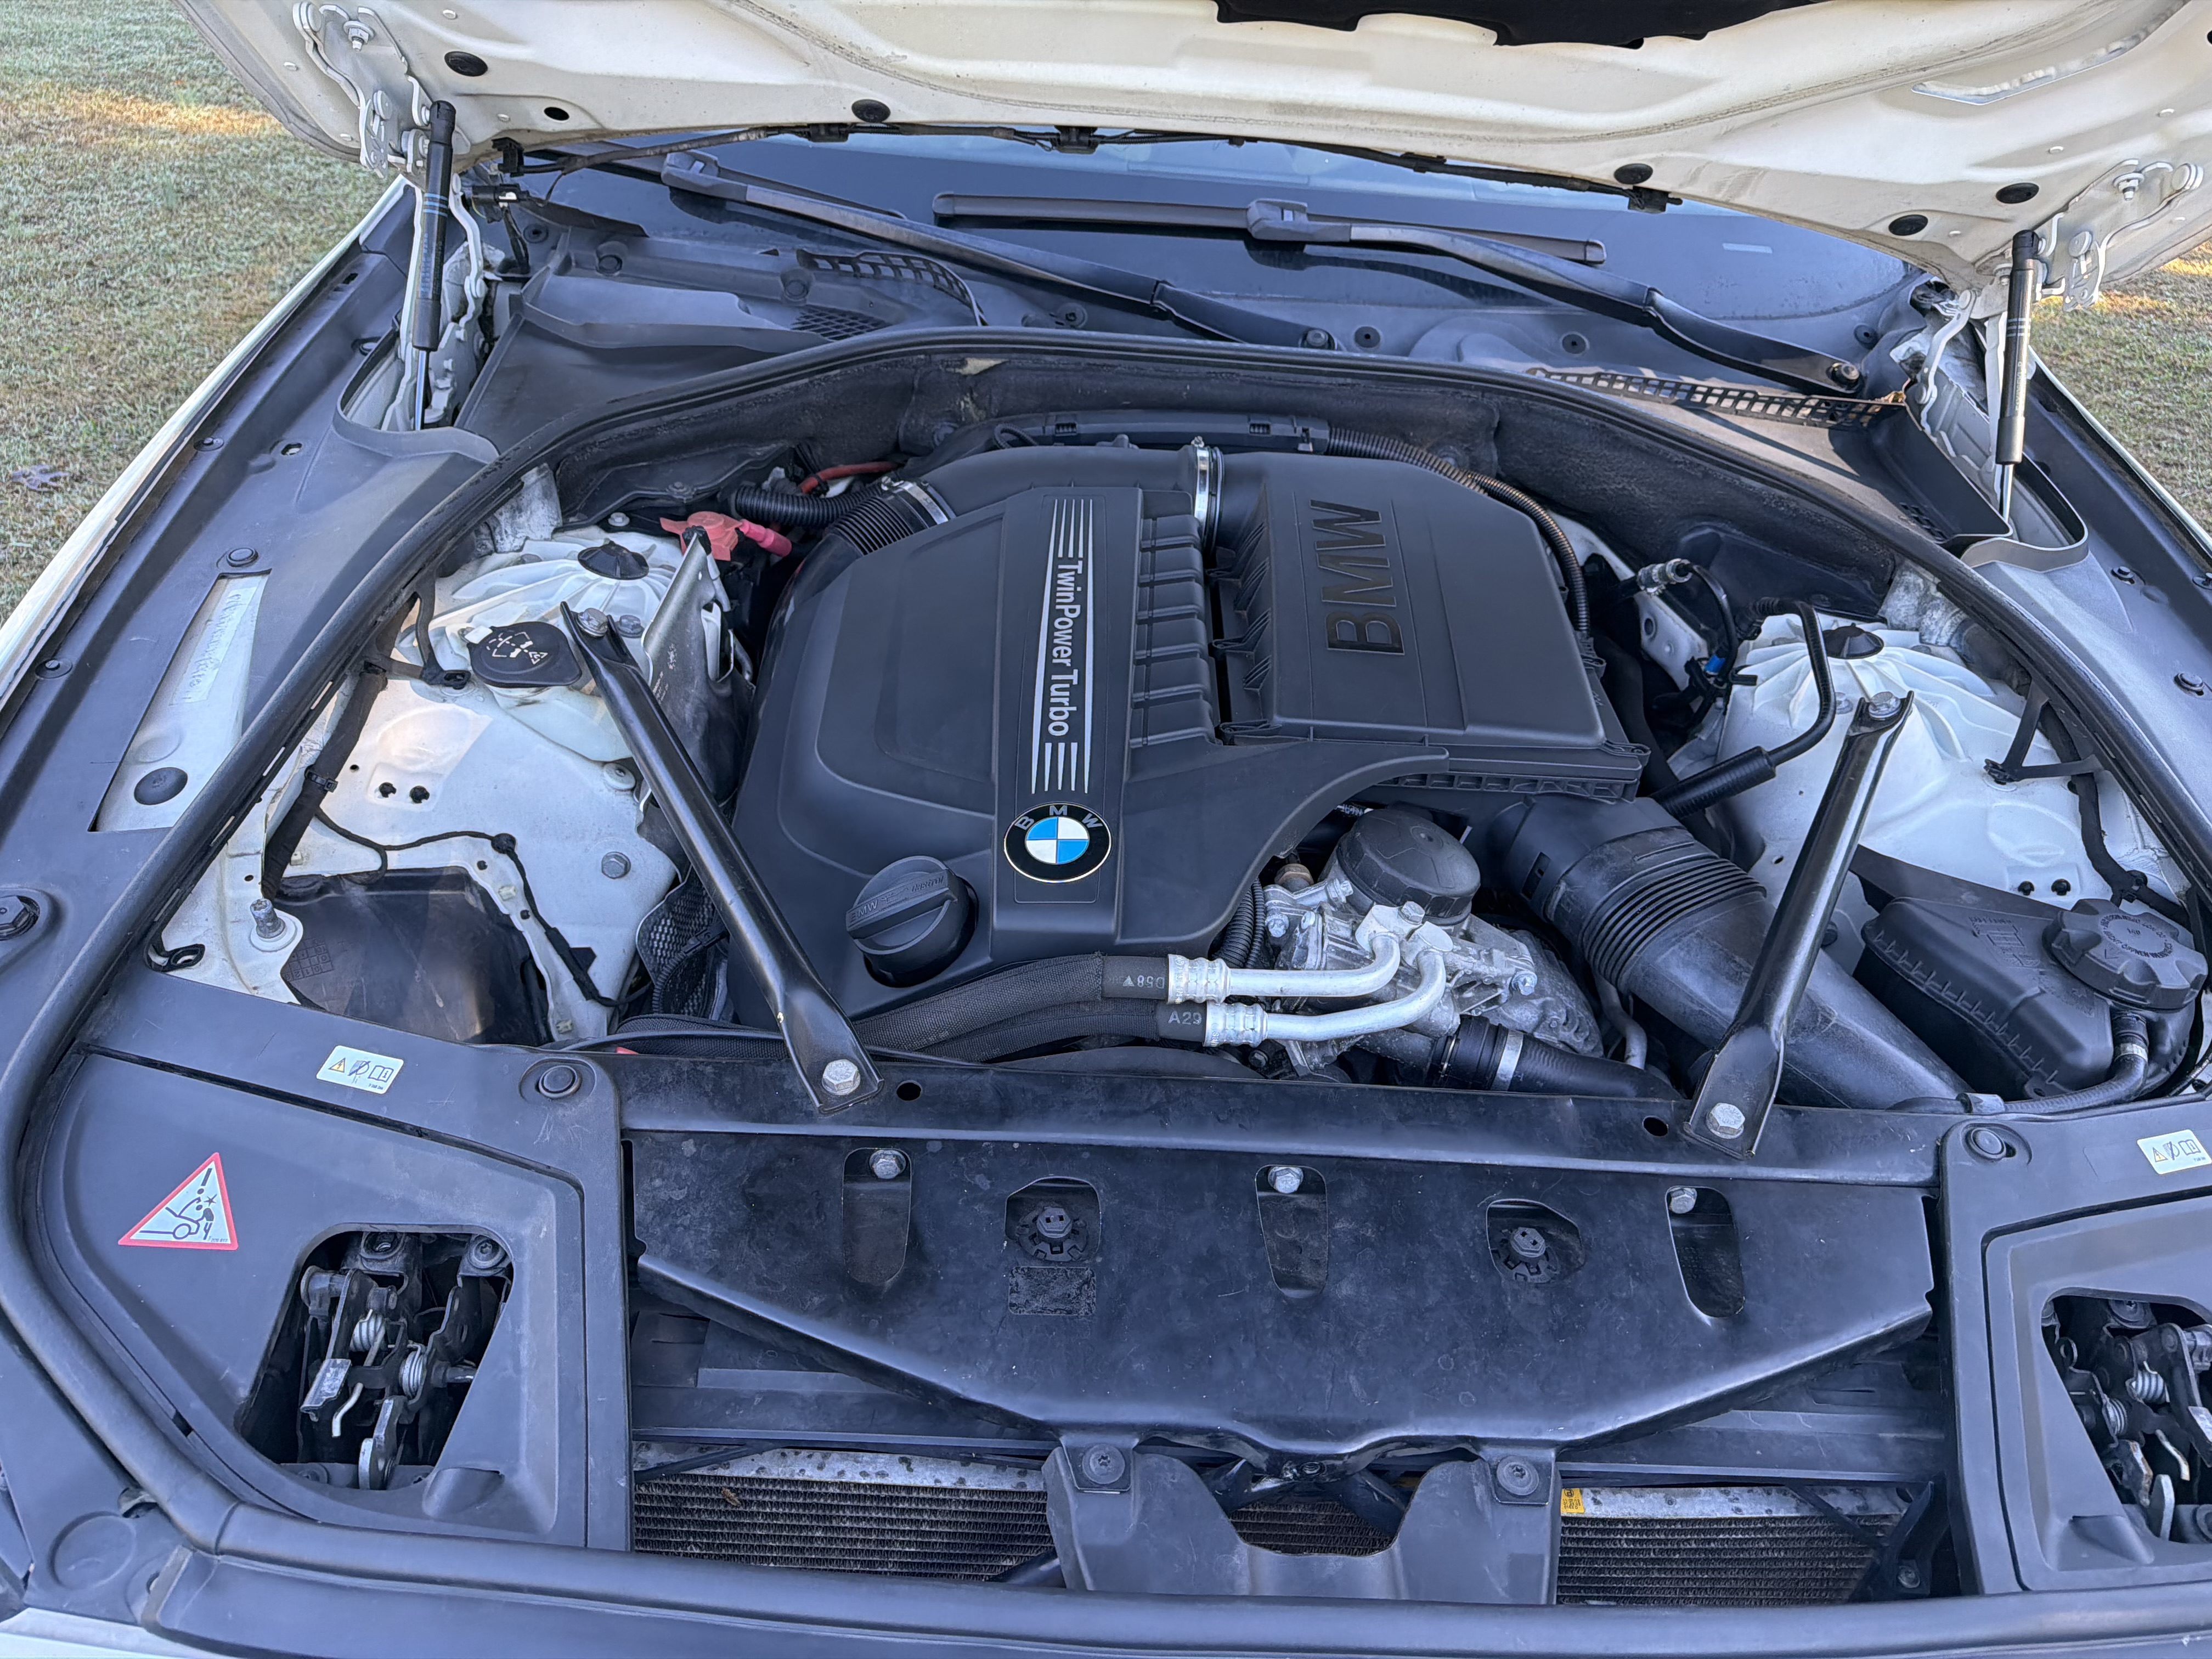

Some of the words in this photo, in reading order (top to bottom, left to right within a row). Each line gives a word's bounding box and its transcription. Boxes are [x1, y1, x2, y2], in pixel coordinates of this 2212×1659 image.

[1310, 499, 1404, 656] BMW
[1052, 561, 1082, 667] TwinPower
[1048, 669, 1078, 736] Turbo
[1014, 805, 1103, 831] BMW
[850, 900, 878, 921] BMW
[1137, 975, 1165, 989] D58
[1168, 1010, 1202, 1025] A29
